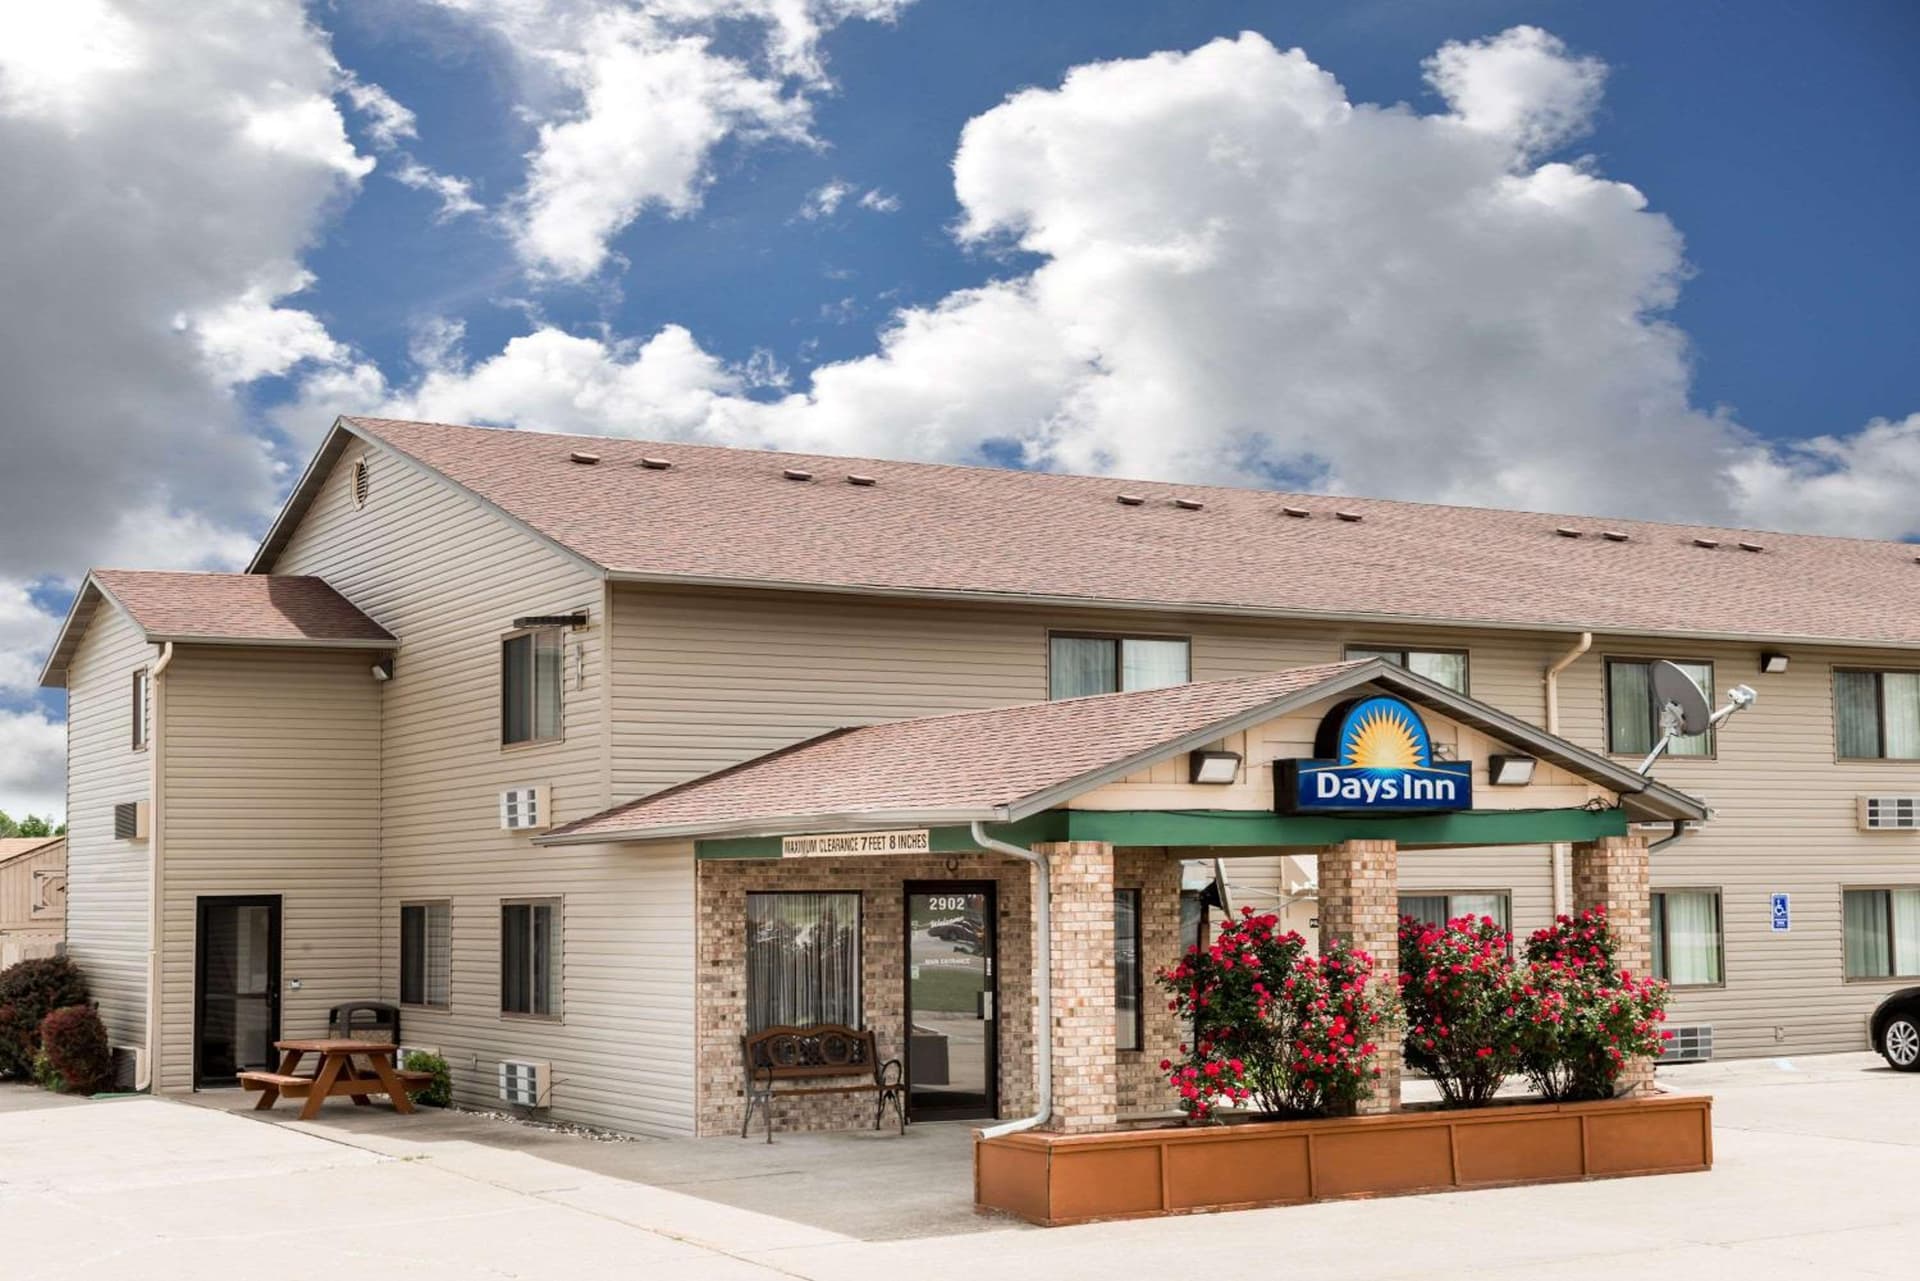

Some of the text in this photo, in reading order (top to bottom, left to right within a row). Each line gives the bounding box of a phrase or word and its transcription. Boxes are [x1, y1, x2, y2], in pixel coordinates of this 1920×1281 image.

[1317, 772, 1456, 803] Days Inn
[784, 833, 927, 854] MAXIMUM CLEARANCE 7 FEET 8 INCHES
[929, 897, 965, 911] 2902
